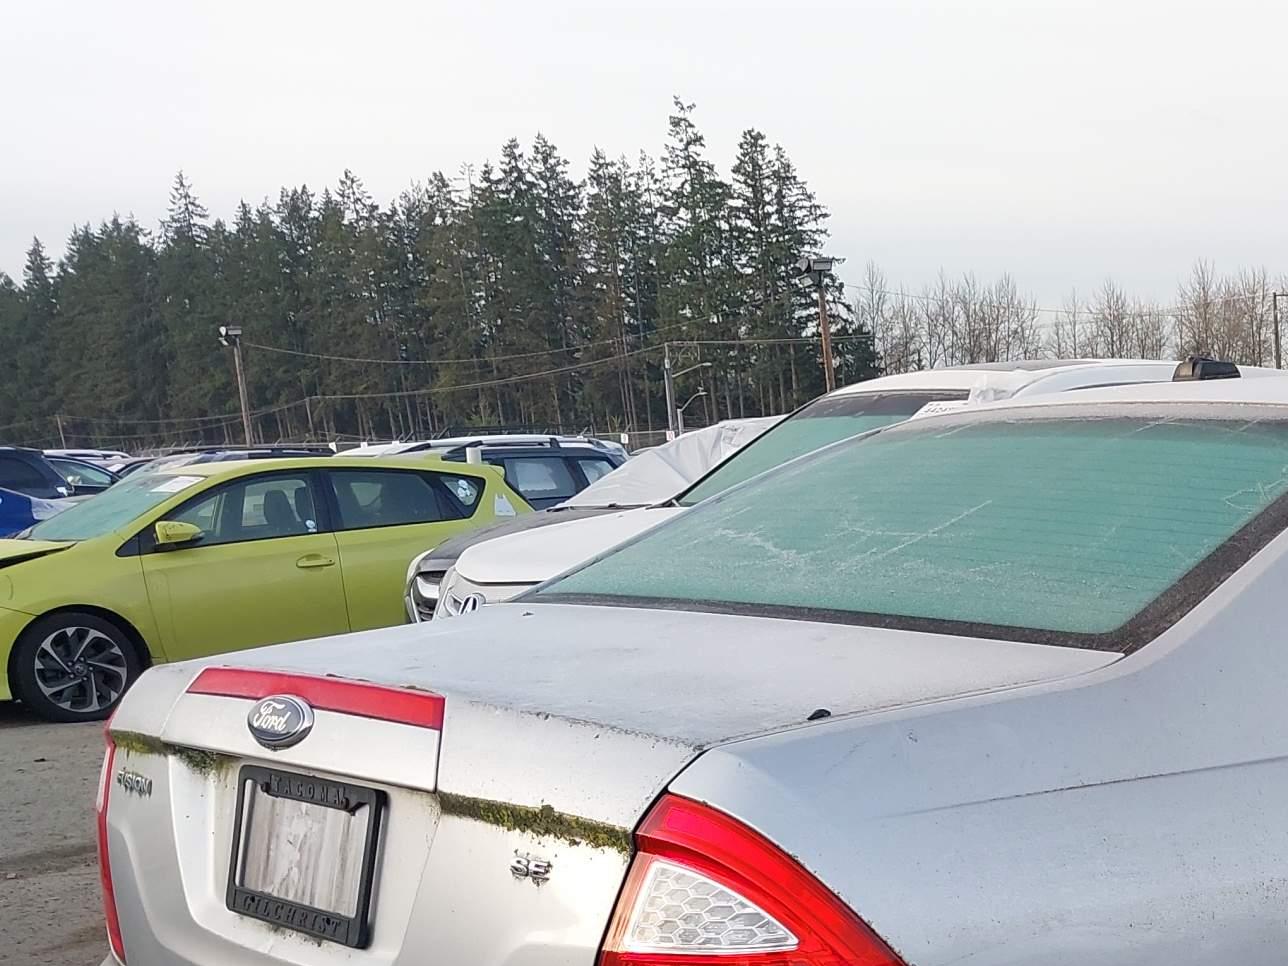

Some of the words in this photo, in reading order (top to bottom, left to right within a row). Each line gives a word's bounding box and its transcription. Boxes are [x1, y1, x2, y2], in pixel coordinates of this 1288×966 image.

[253, 700, 292, 731] Ford
[270, 775, 347, 806] TACOMA
[510, 857, 550, 880] SE
[243, 894, 342, 934] GILCHRIST
